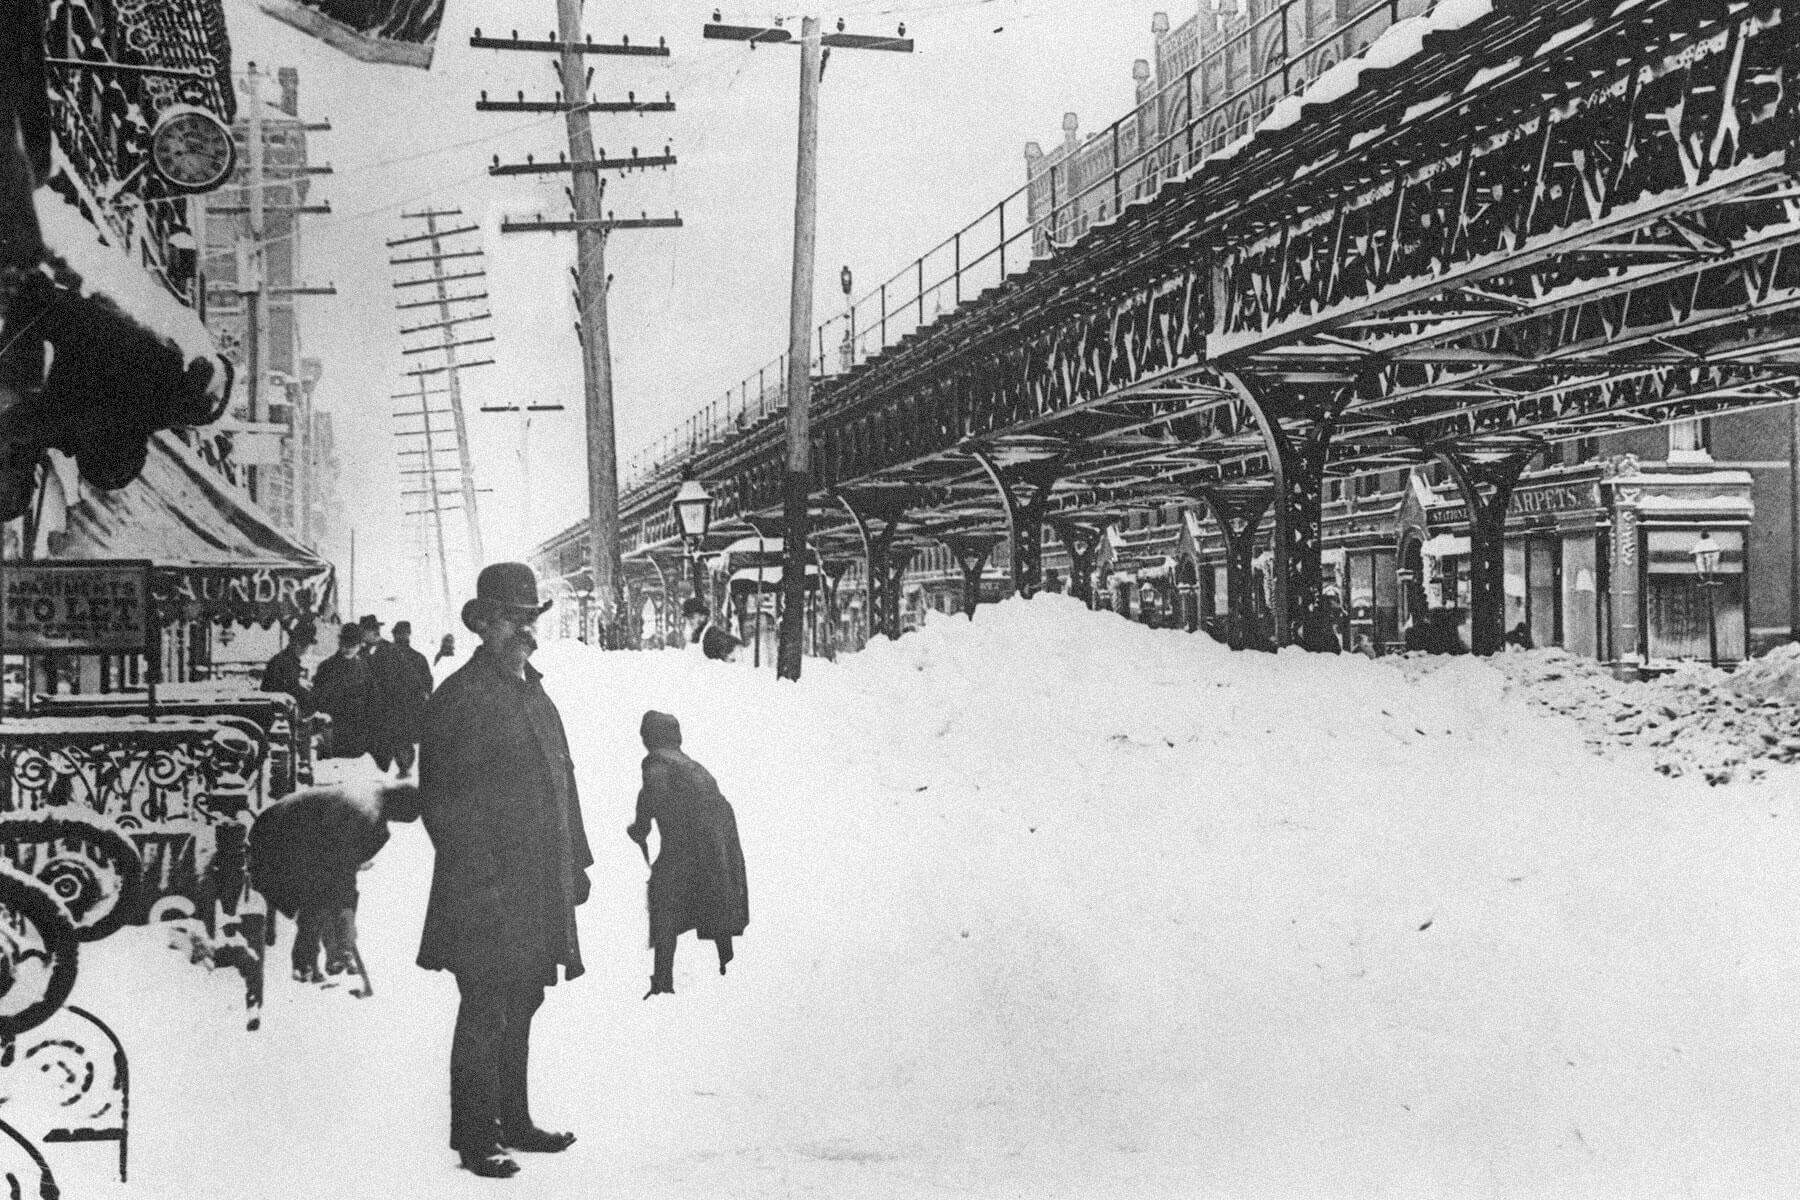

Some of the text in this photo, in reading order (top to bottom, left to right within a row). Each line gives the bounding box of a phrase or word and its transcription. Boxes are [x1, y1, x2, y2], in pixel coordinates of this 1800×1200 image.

[1506, 486, 1581, 514] ARPETS.
[7, 597, 138, 622] TO LET
